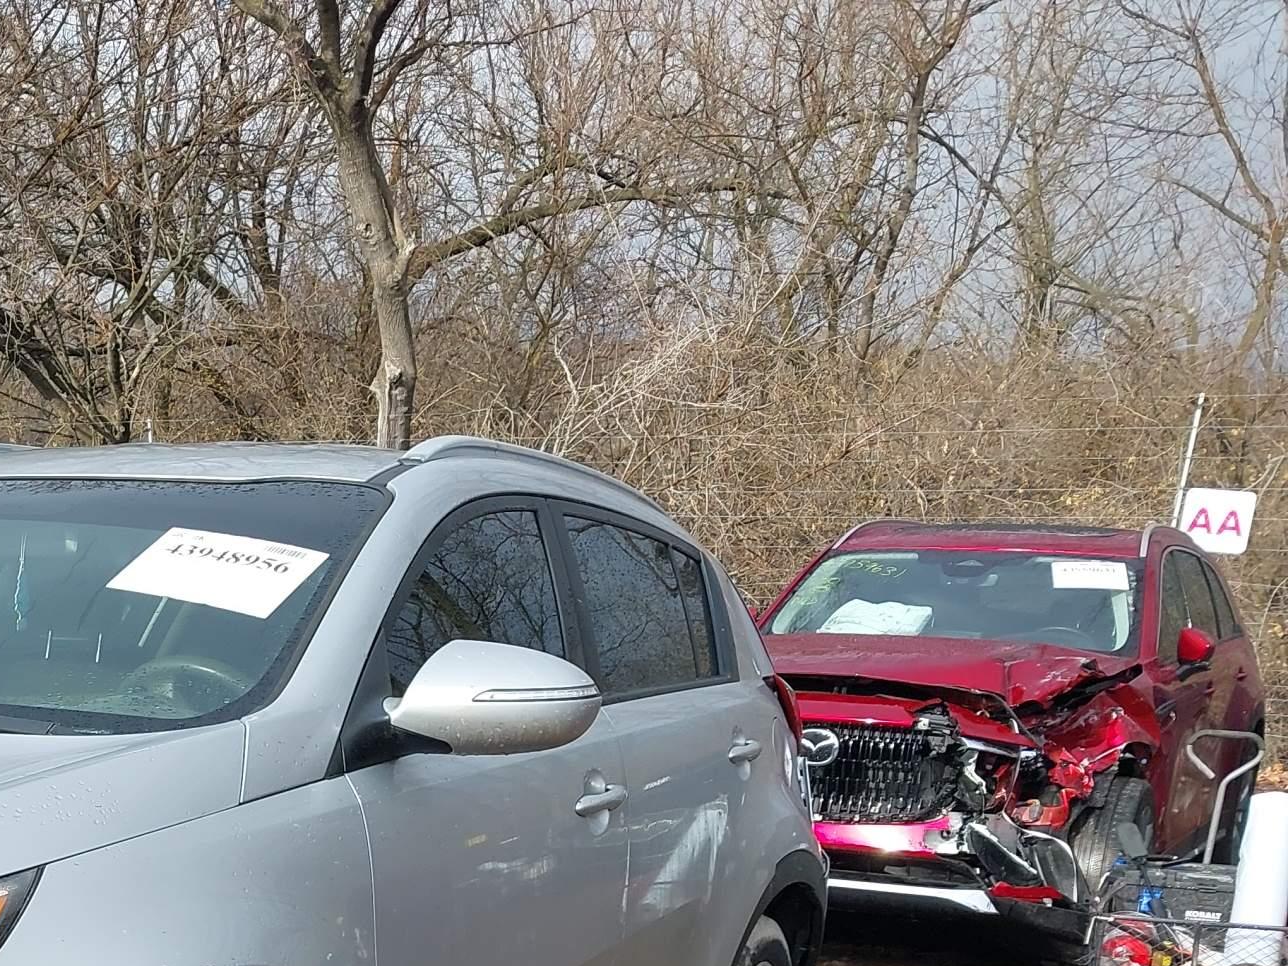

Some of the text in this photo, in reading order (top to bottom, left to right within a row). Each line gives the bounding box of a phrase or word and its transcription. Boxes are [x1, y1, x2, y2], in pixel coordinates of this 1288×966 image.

[1186, 507, 1242, 536] AA
[165, 542, 290, 574] 43948956
[1184, 910, 1223, 920] KOBALT
